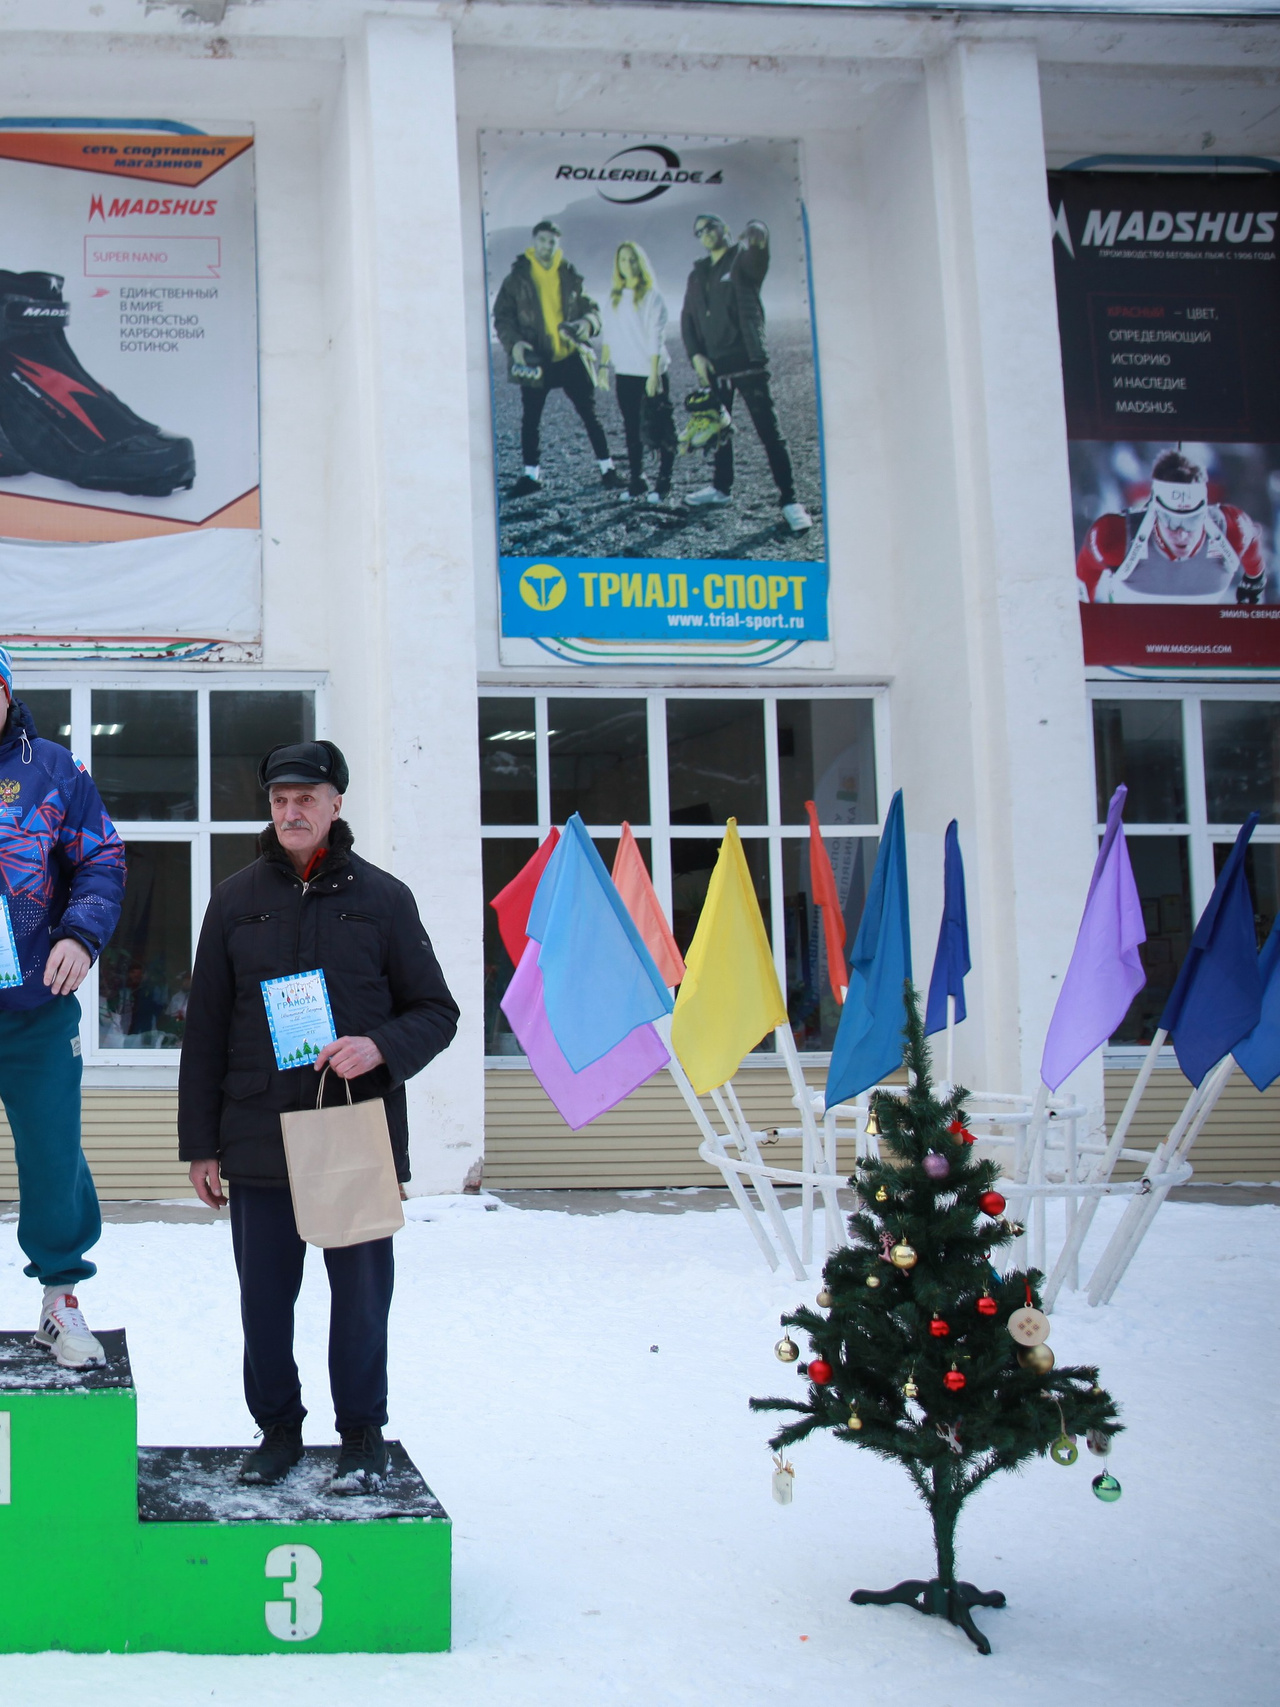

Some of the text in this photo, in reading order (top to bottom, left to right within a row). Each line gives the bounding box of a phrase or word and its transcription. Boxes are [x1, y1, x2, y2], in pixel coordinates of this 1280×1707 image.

[123, 146, 226, 158] спортивных
[114, 158, 204, 168] магазинов
[108, 198, 218, 217] MADSHUS
[1080, 209, 1279, 247] MADSHUS
[93, 251, 168, 263] SUPER NANO
[120, 287, 218, 300] ЕДИНСТВЕННЫЙ
[120, 301, 164, 312] В МИРЕ
[120, 315, 199, 326] ПОЛНОСТЬЮ
[120, 327, 205, 339] КАРБОНОВЫЙ
[1109, 329, 1211, 344] ОПРЕДЕЛЯЮЩИЙ
[120, 342, 179, 352] БОТИНОК
[1112, 353, 1170, 366] ИСТОРИЮ
[1114, 377, 1187, 391] И НАСЛЕДИЕ
[667, 613, 804, 631] www.trial-sport.ru
[277, 995, 317, 1010] ГРАМОТА
[265, 1544, 323, 1641] 3
